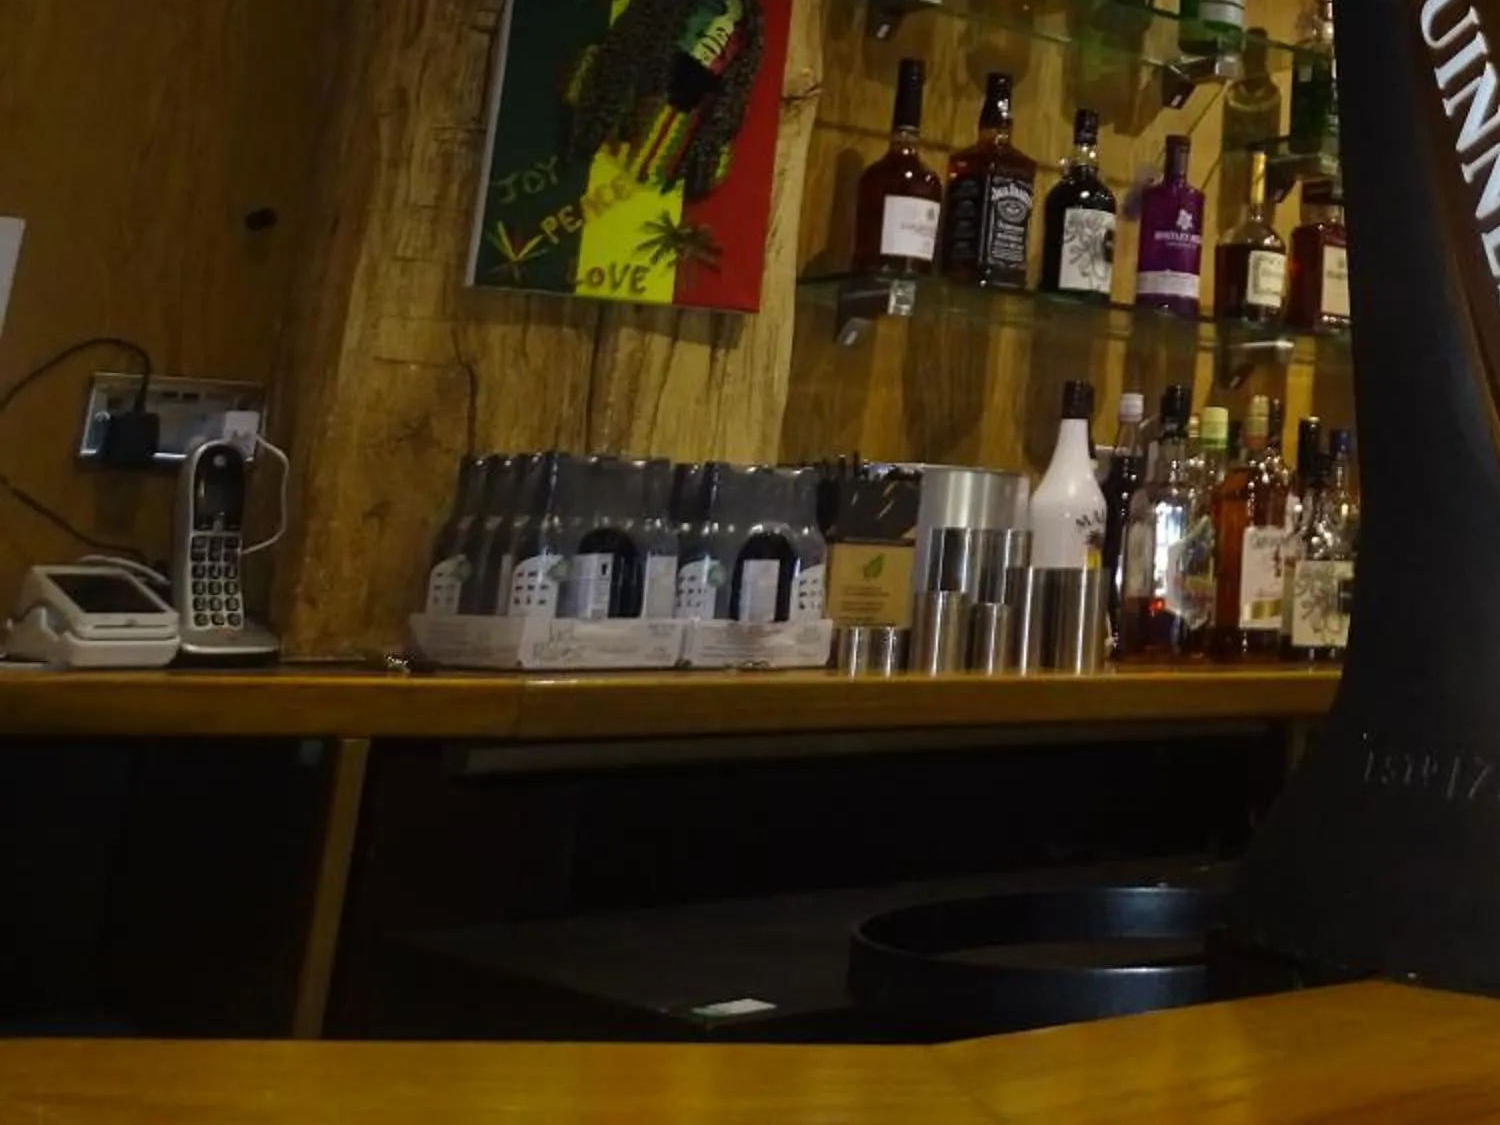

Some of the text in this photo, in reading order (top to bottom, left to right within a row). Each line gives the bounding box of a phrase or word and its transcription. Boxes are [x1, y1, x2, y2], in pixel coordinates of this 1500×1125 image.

[490, 155, 559, 205] JOY
[539, 175, 636, 245] PEACE
[567, 259, 649, 294] LOVE
